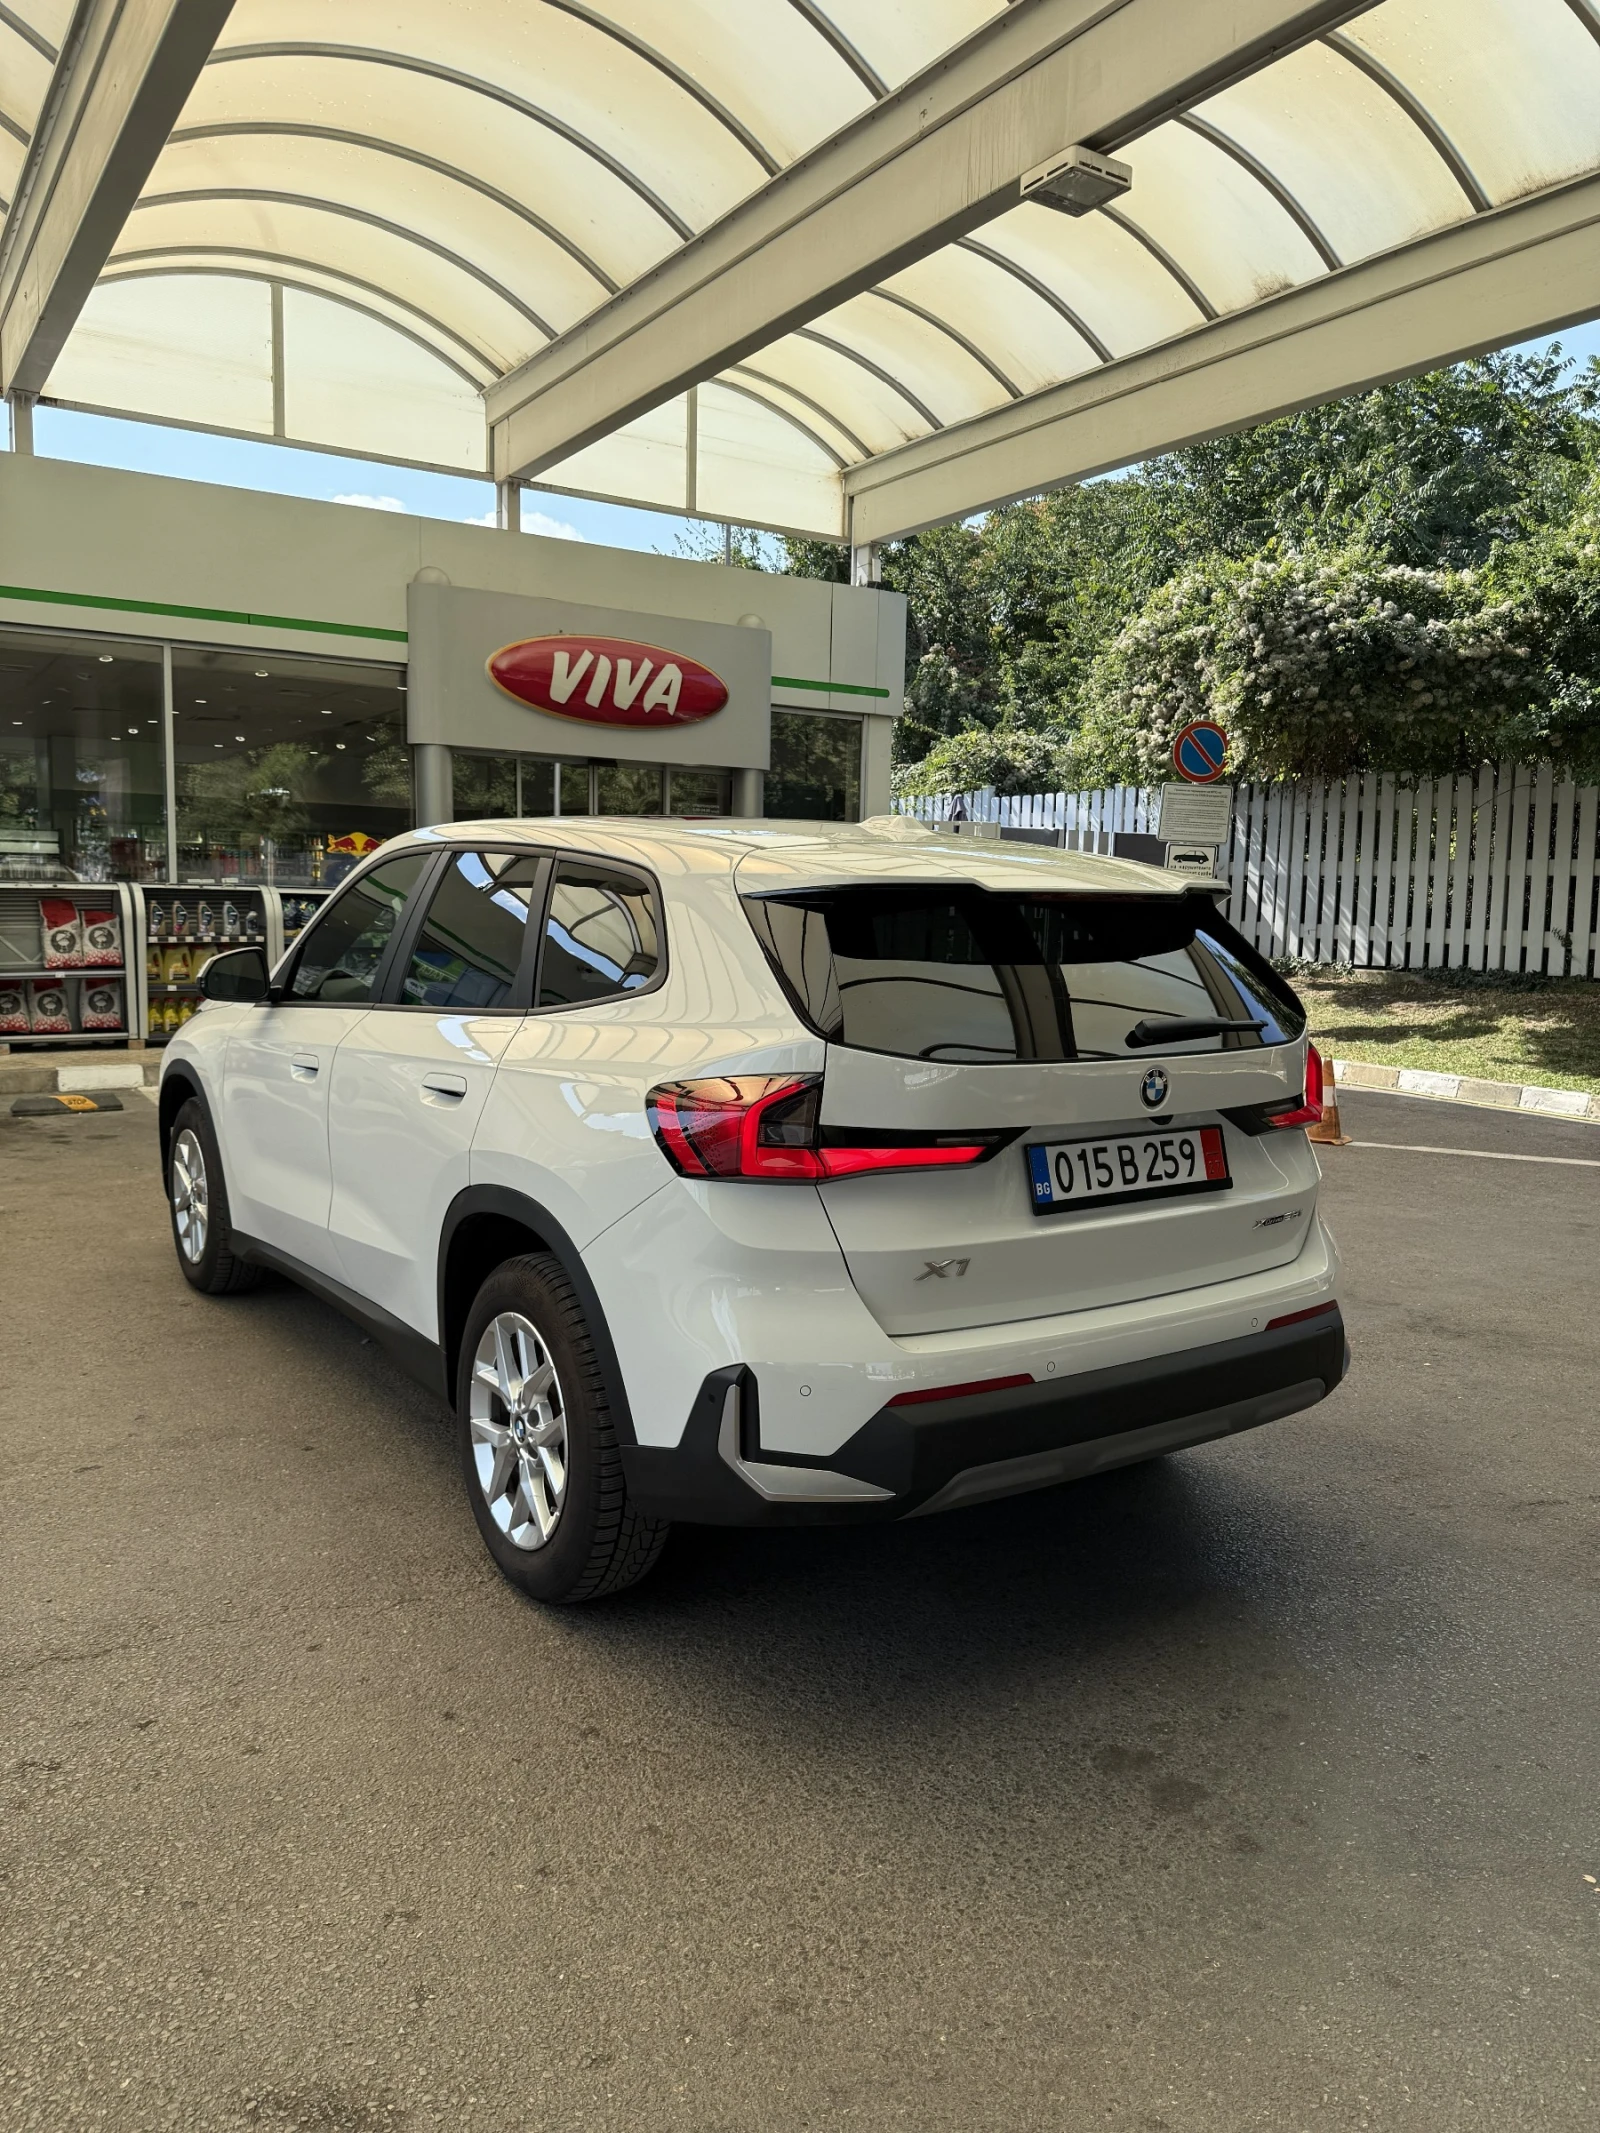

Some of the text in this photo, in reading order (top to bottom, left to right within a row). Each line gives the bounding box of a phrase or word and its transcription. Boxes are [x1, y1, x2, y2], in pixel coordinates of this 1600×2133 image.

[550, 649, 683, 716] VIVA
[1035, 1182, 1051, 1196] BG
[913, 1257, 971, 1281] X1
